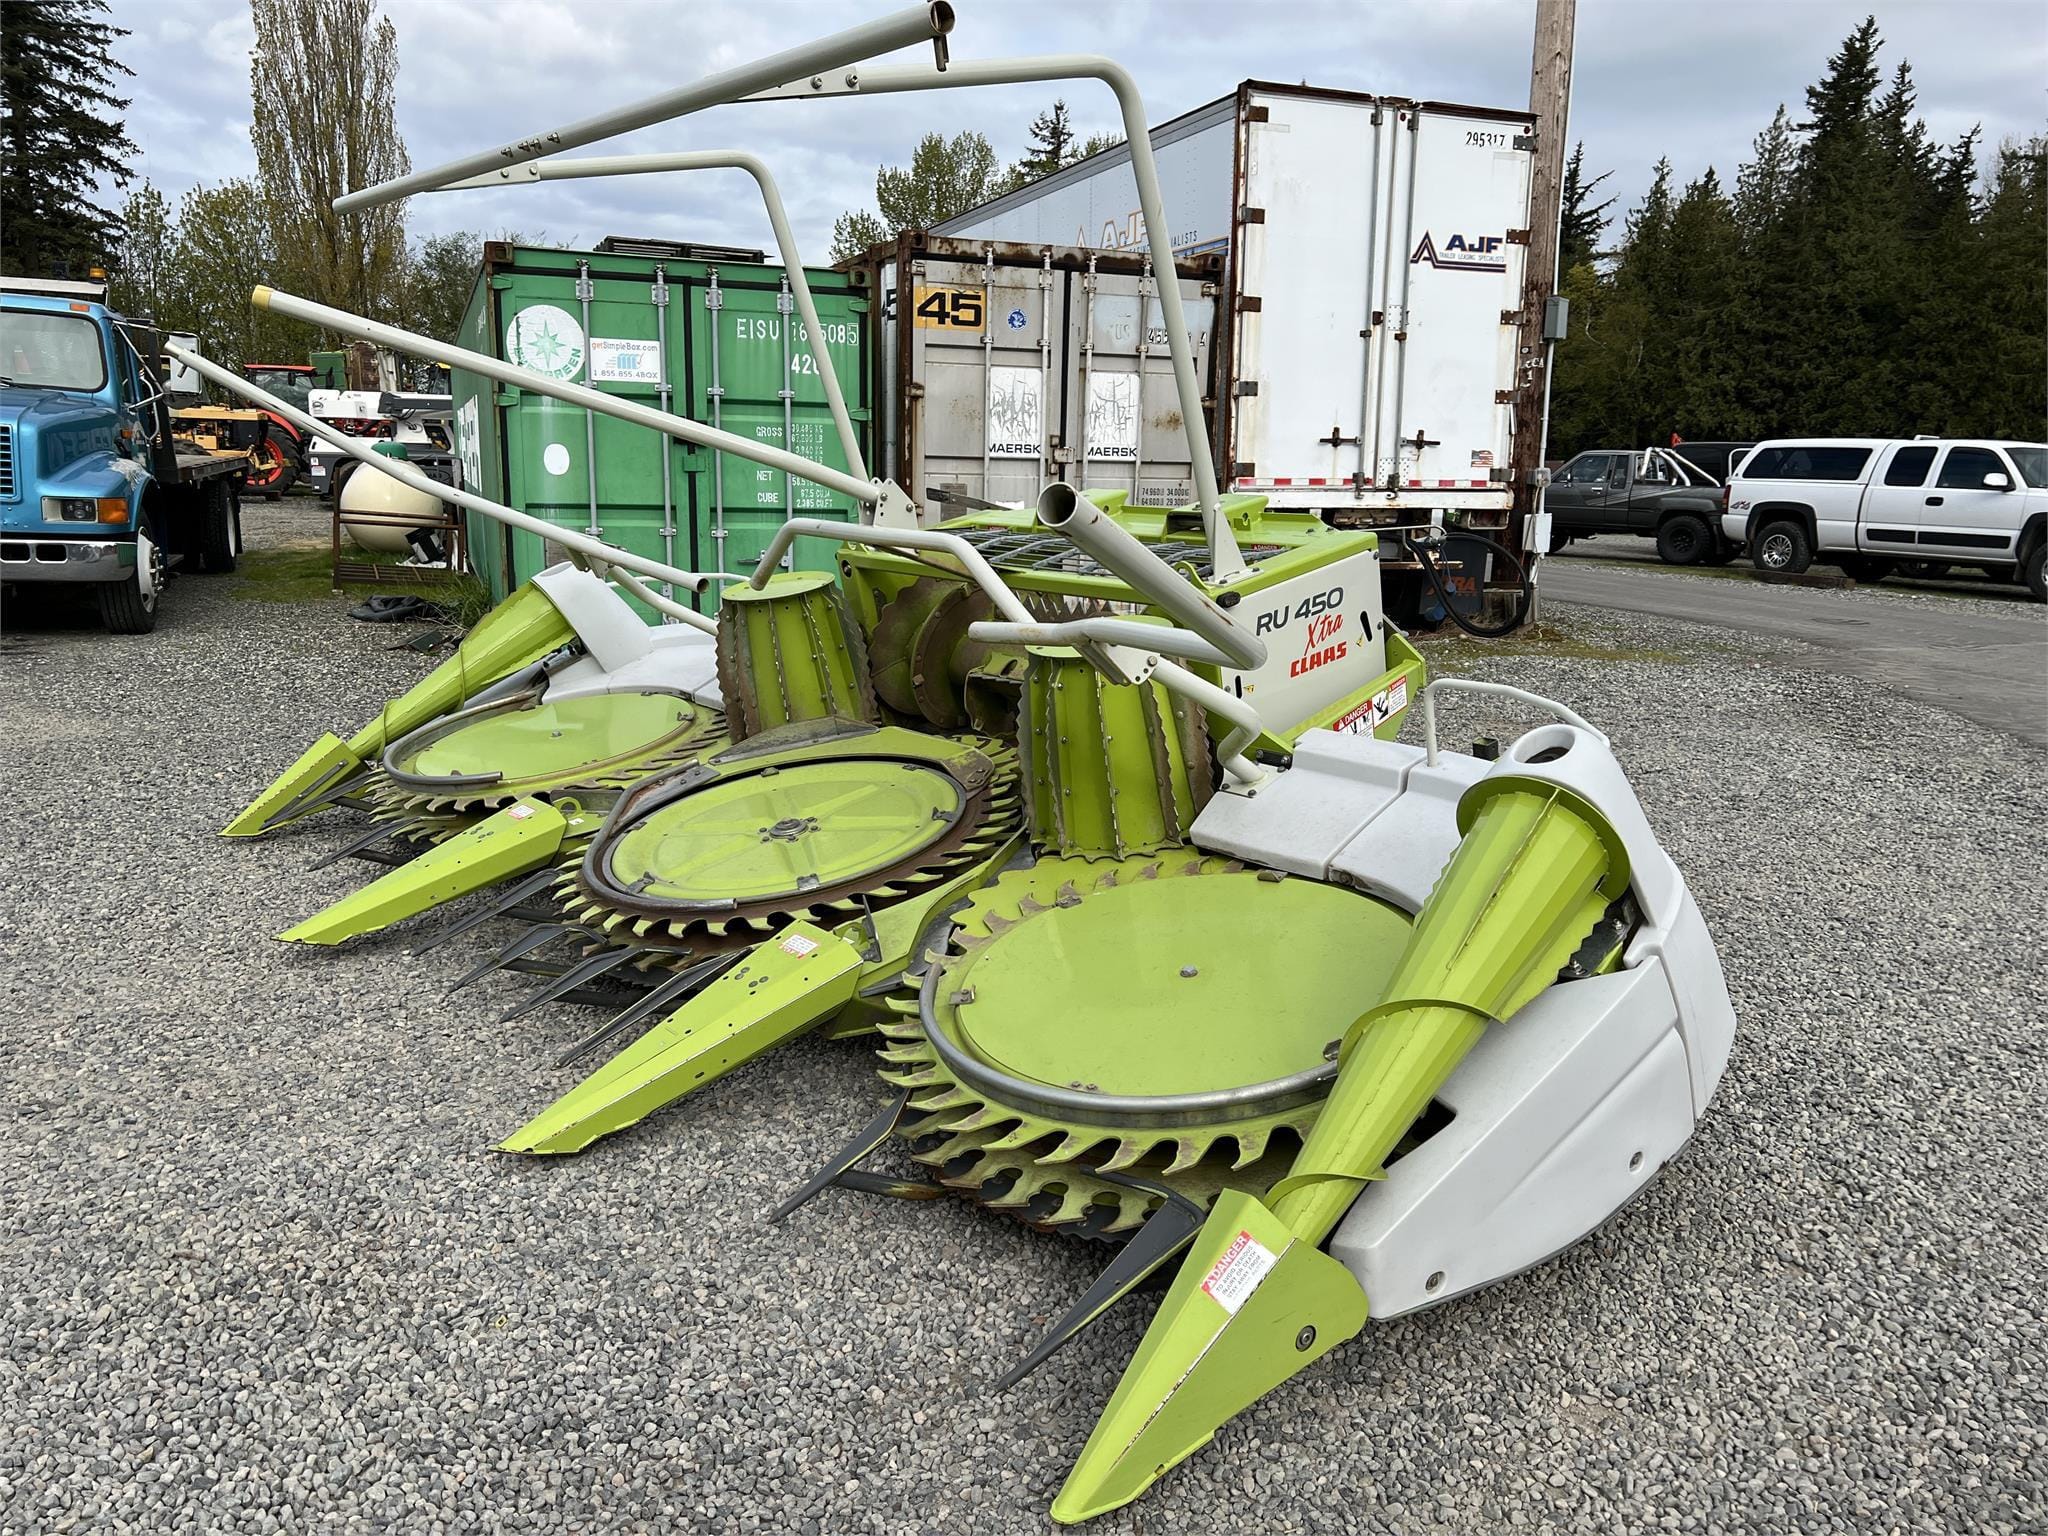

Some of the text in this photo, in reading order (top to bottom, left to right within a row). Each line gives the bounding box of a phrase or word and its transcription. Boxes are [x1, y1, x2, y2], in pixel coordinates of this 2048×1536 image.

[1445, 234, 1503, 253] AJF
[917, 291, 981, 327] 45
[736, 318, 780, 340] EISU
[591, 341, 658, 352] getSimpleBox.com
[756, 426, 783, 437] GROSS
[988, 443, 1041, 454] MAERSK
[1087, 446, 1137, 457] MAERSK
[756, 470, 774, 481] NET
[757, 492, 779, 503] CUBE
[1256, 587, 1344, 636] RU 450
[1304, 614, 1344, 656] Xtra
[1290, 641, 1347, 678] CLAAS
[1344, 702, 1369, 724] DANGER
[1211, 1235, 1247, 1279] DANGER
